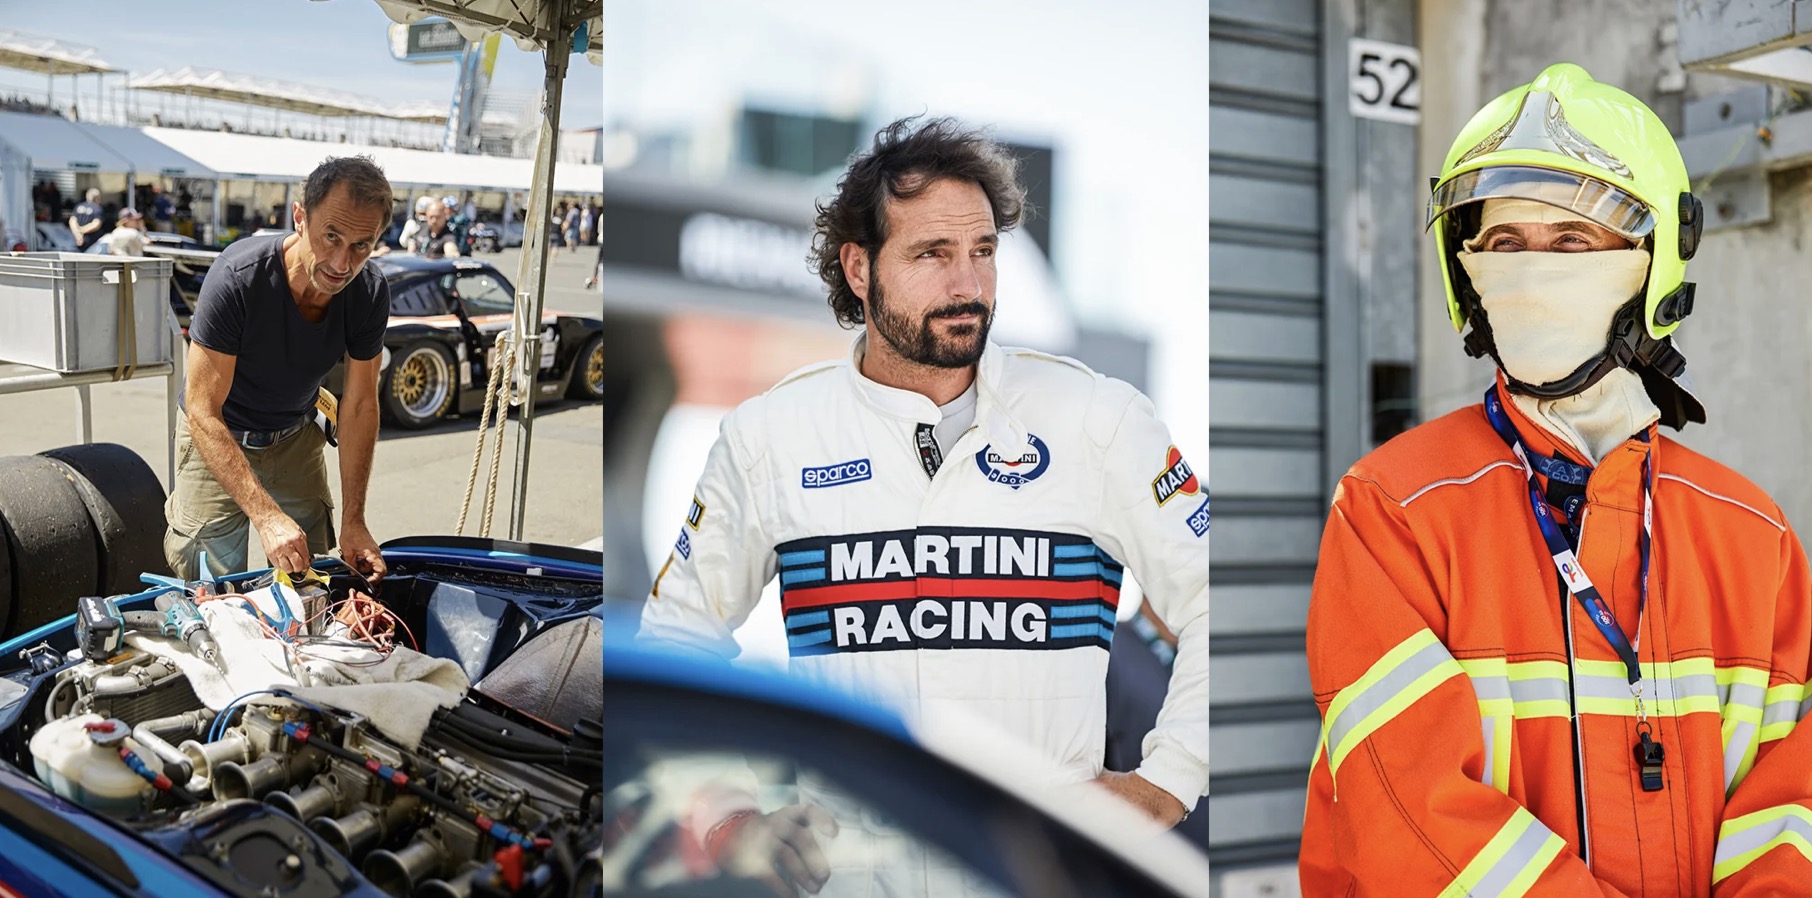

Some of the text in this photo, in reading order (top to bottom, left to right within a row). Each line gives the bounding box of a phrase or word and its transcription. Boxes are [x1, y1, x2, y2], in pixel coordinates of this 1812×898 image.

[1357, 53, 1420, 111] 52
[803, 461, 870, 488] sparco
[830, 534, 1050, 582] MARTINI
[833, 599, 1048, 648] RACING
